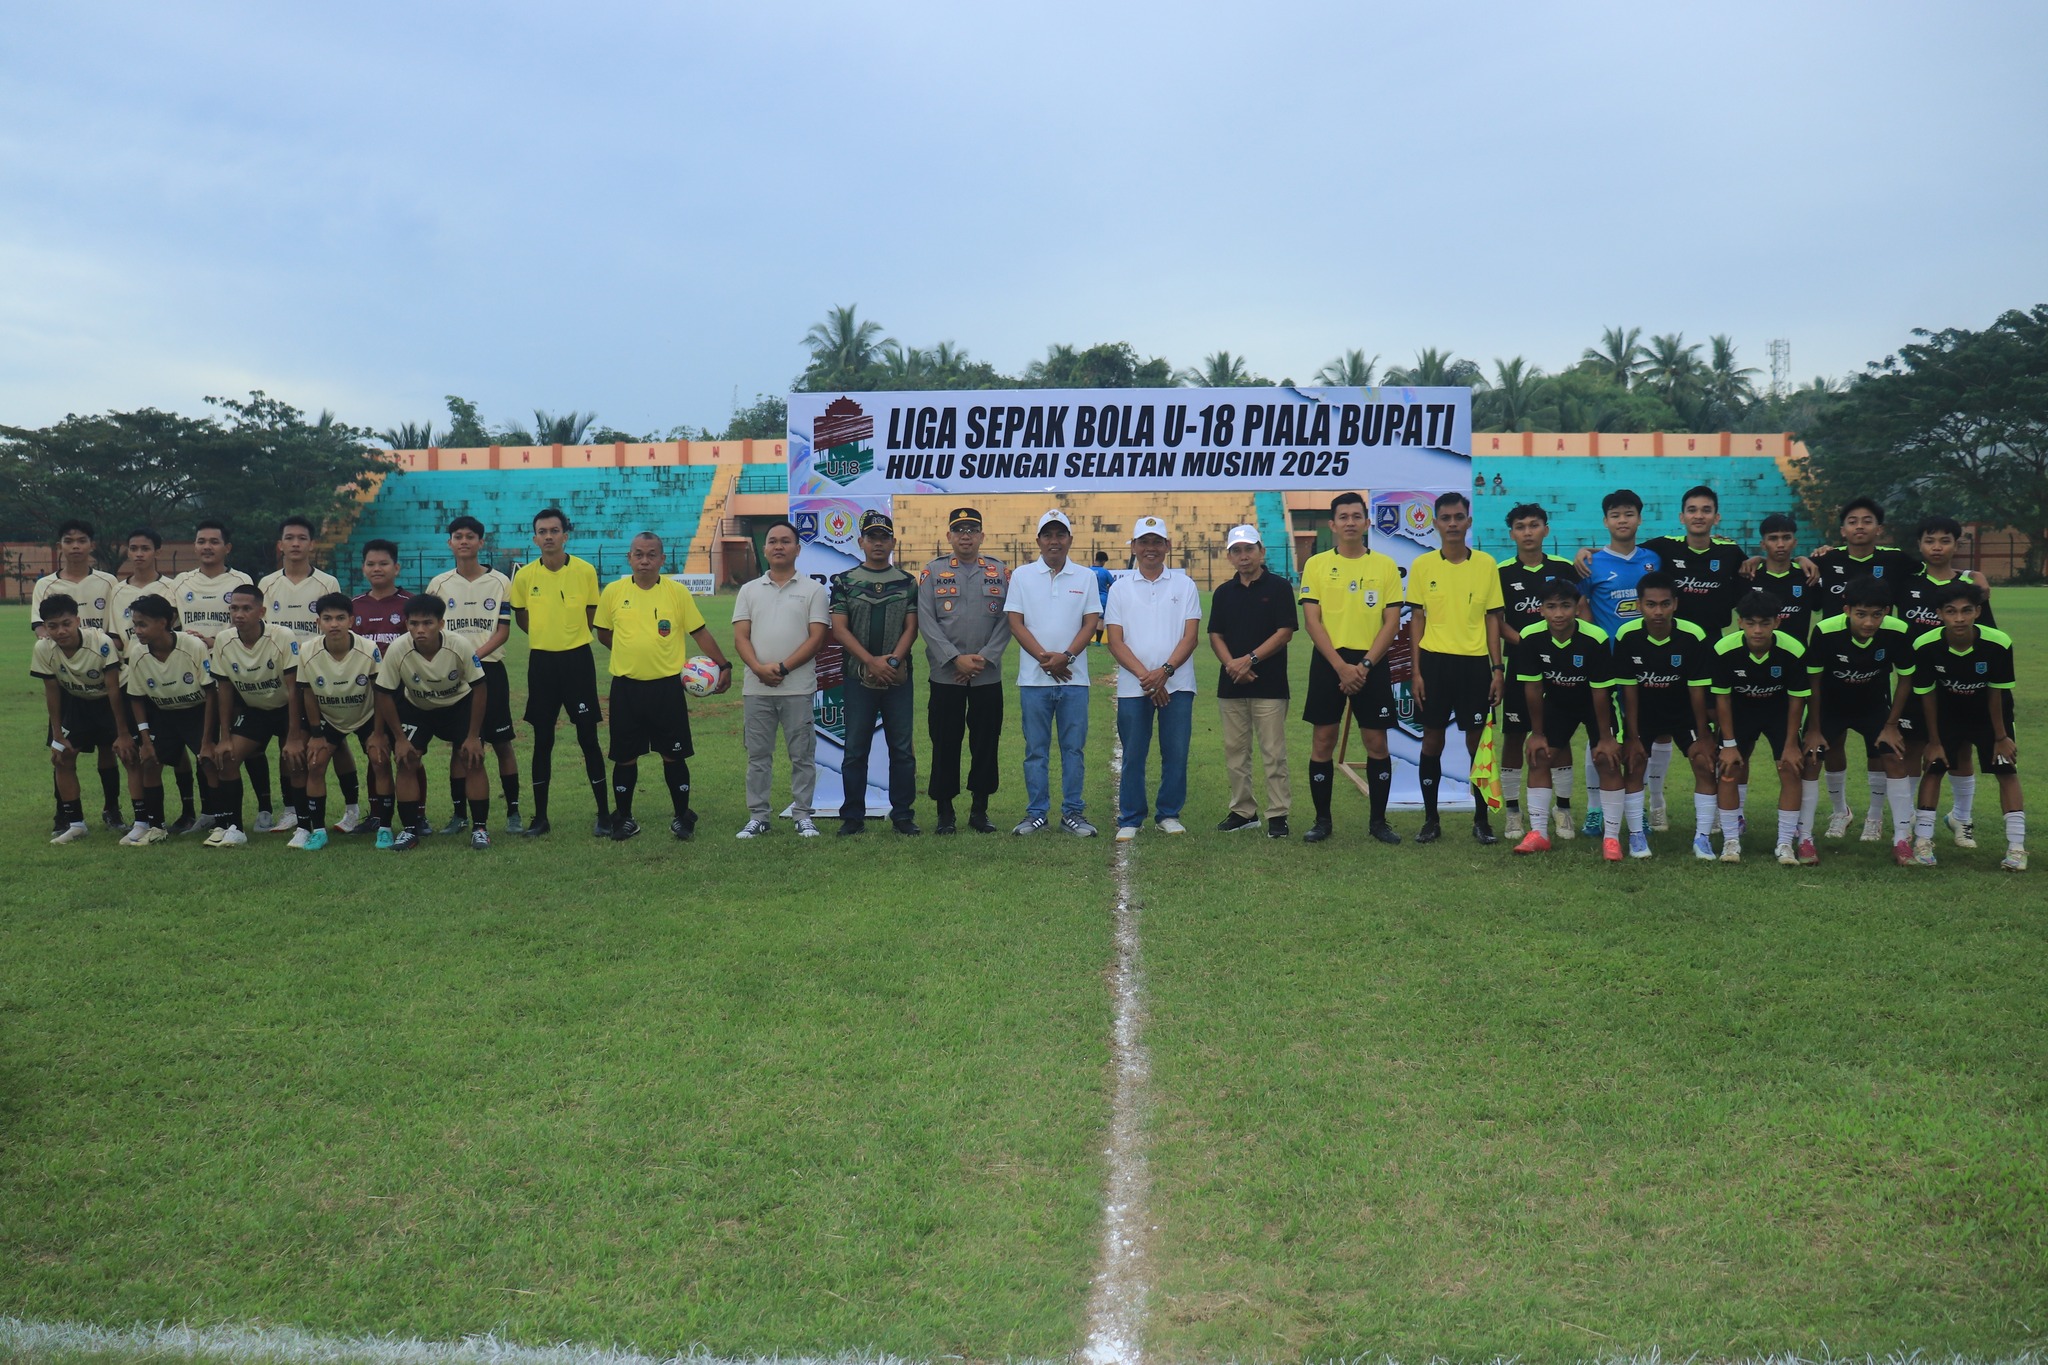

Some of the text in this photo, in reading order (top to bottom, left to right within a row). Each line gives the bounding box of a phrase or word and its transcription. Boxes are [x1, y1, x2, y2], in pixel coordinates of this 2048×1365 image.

[886, 403, 1455, 450] LIGA SEPAK BOLA U-18 PIALA BUPATI
[826, 460, 861, 476] U18
[885, 451, 1350, 480] HULU SUNGAI SELATAN MUSIM 2025
[1674, 576, 1721, 589] Hana
[184, 611, 232, 624] TELAGA LANGSA
[446, 618, 469, 631] TELAGA
[1636, 671, 1681, 684] Hana
